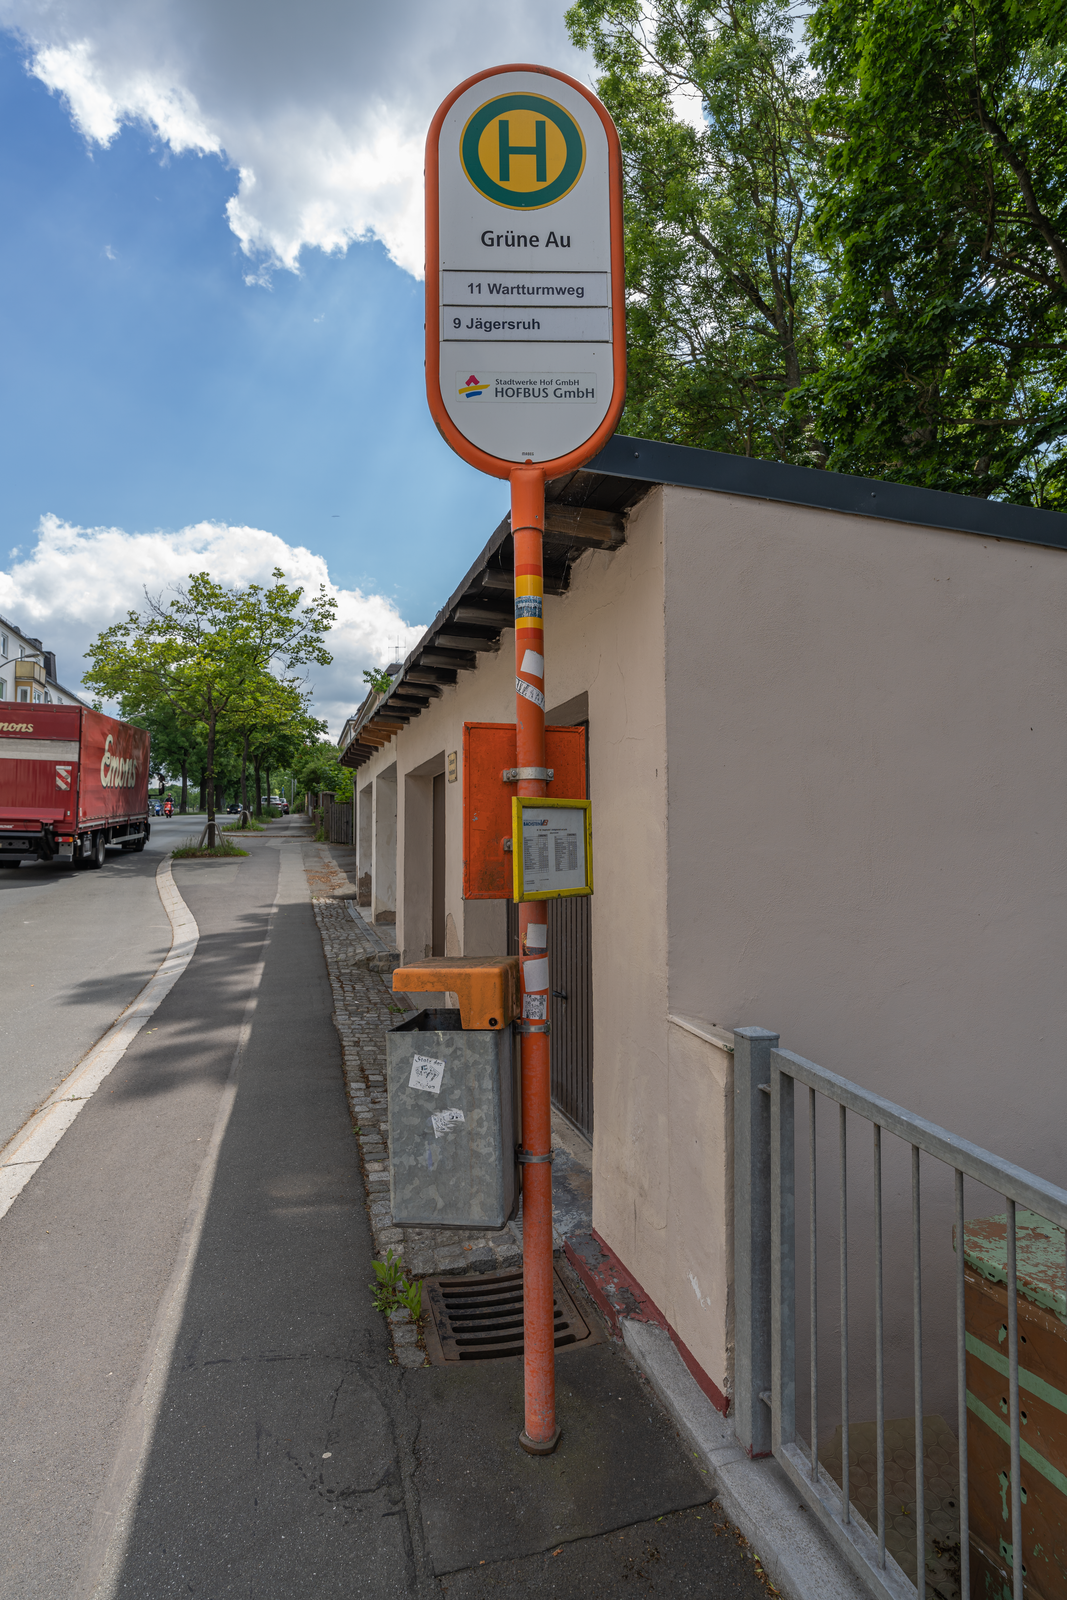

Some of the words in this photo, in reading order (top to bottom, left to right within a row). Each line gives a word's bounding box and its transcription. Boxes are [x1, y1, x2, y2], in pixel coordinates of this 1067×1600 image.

[499, 120, 547, 182] H
[481, 230, 539, 247] Grüne
[545, 231, 571, 247] Au
[467, 283, 481, 294] 11
[488, 283, 585, 298] Wartturmweg
[453, 318, 461, 329] 9
[466, 318, 540, 332] Jägersruh
[495, 387, 549, 398] HOFBUS
[553, 388, 595, 398] GmbH
[100, 734, 137, 789] Emons
